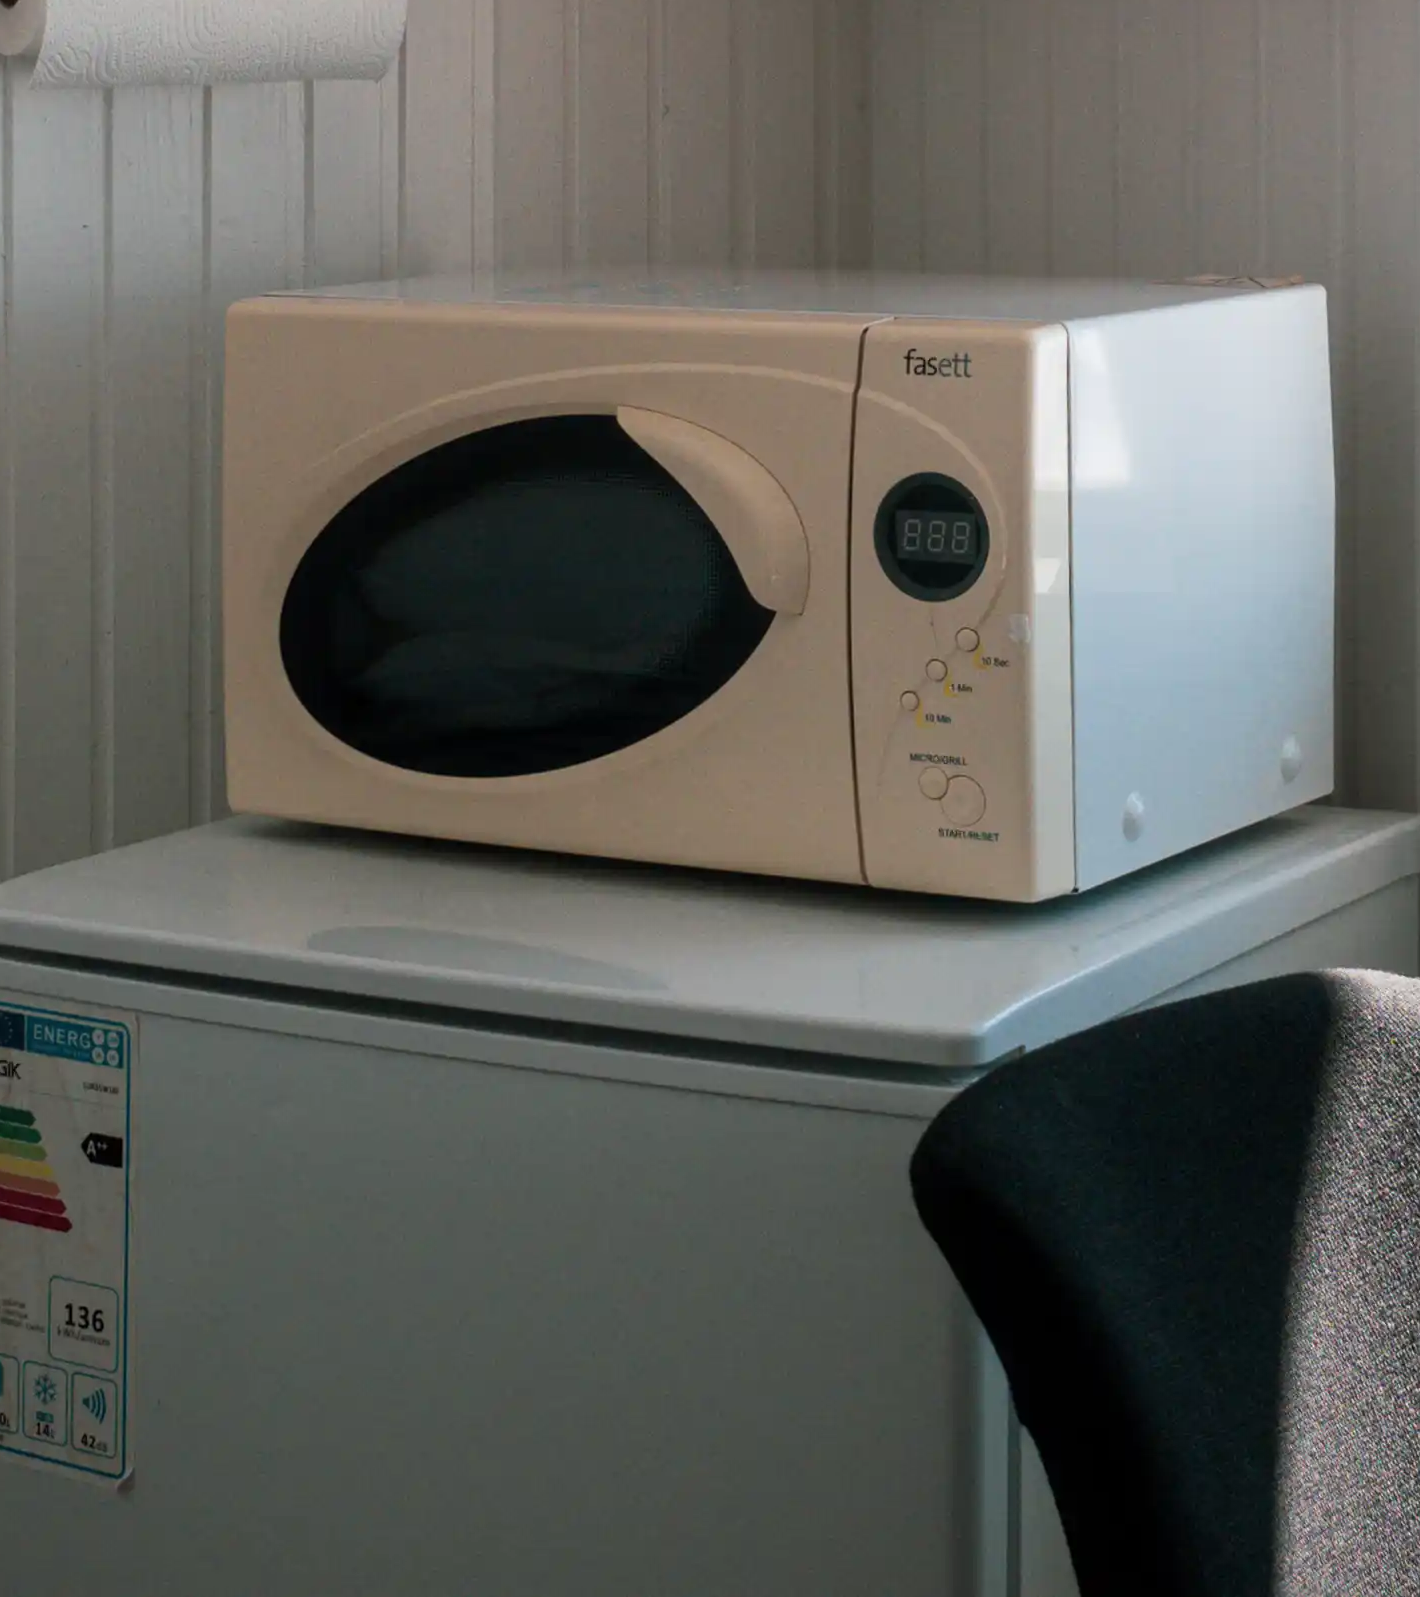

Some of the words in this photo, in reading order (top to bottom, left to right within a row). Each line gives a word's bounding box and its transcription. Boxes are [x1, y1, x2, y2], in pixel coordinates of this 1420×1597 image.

[903, 348, 972, 378] fasett
[33, 1023, 91, 1050] ENERG
[86, 1138, 109, 1159] A++
[64, 1303, 105, 1333] 136
